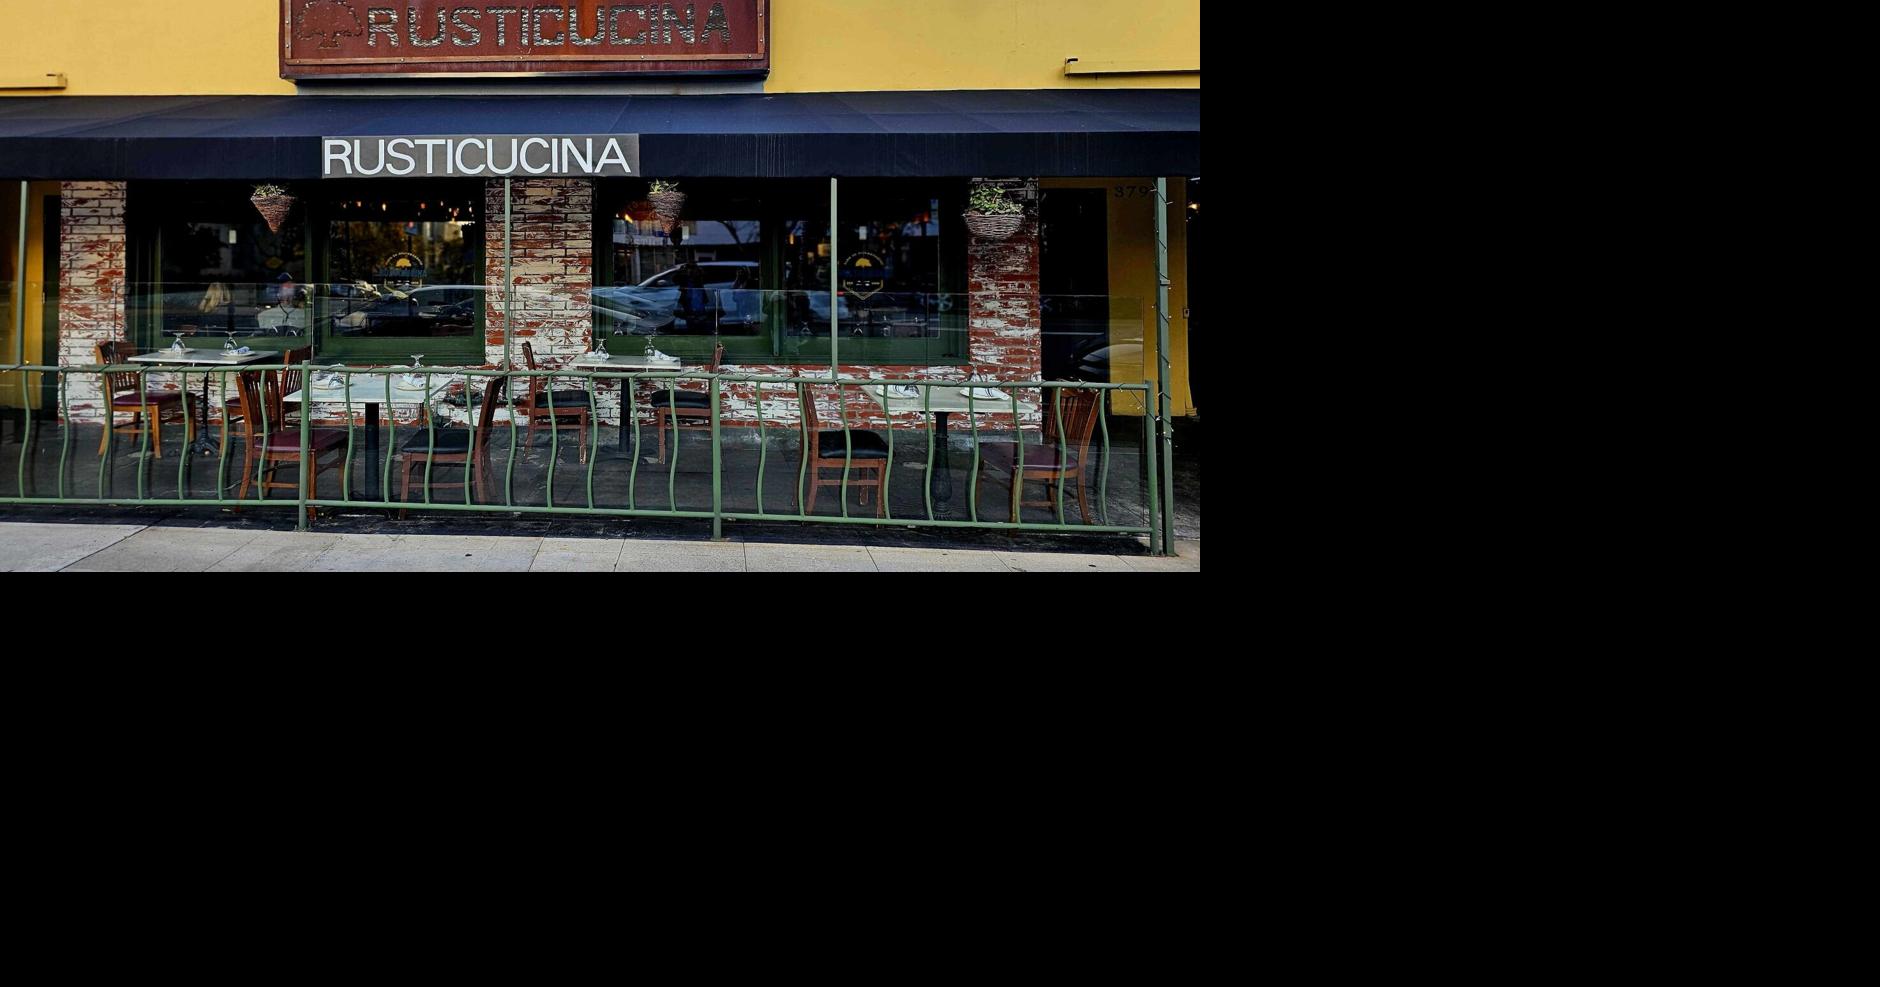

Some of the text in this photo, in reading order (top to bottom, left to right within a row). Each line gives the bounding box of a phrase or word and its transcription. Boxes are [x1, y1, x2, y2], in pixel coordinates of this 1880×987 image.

[367, 2, 731, 47] RUSTICUCINA
[324, 137, 631, 175] RUSTICUCINA
[1114, 185, 1155, 198] 379
